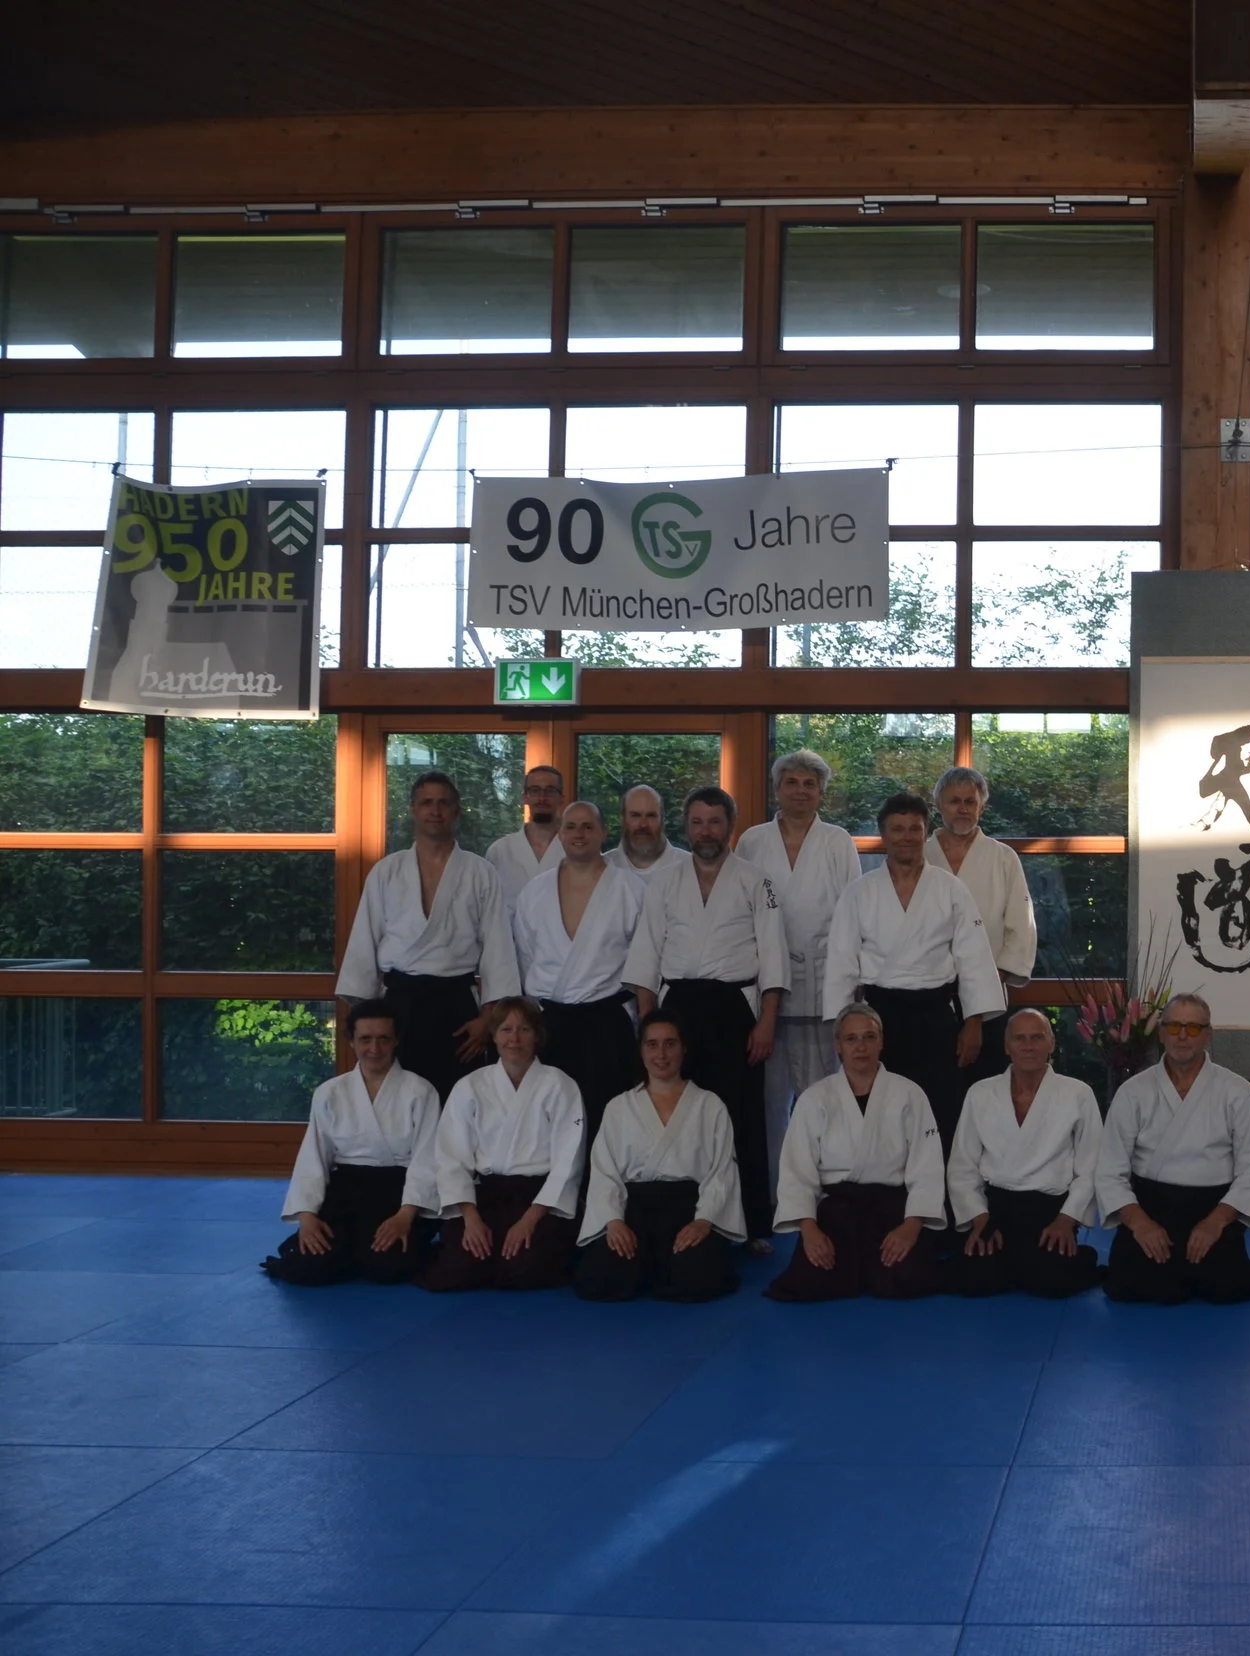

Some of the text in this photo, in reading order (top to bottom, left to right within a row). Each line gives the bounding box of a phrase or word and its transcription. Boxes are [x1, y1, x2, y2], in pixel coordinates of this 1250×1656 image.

[118, 482, 249, 521] HADERN
[112, 514, 248, 583] 950
[505, 496, 857, 566] 90 Jahre
[195, 571, 296, 607] JAHRE
[489, 579, 873, 621] TSV München-Großhadern
